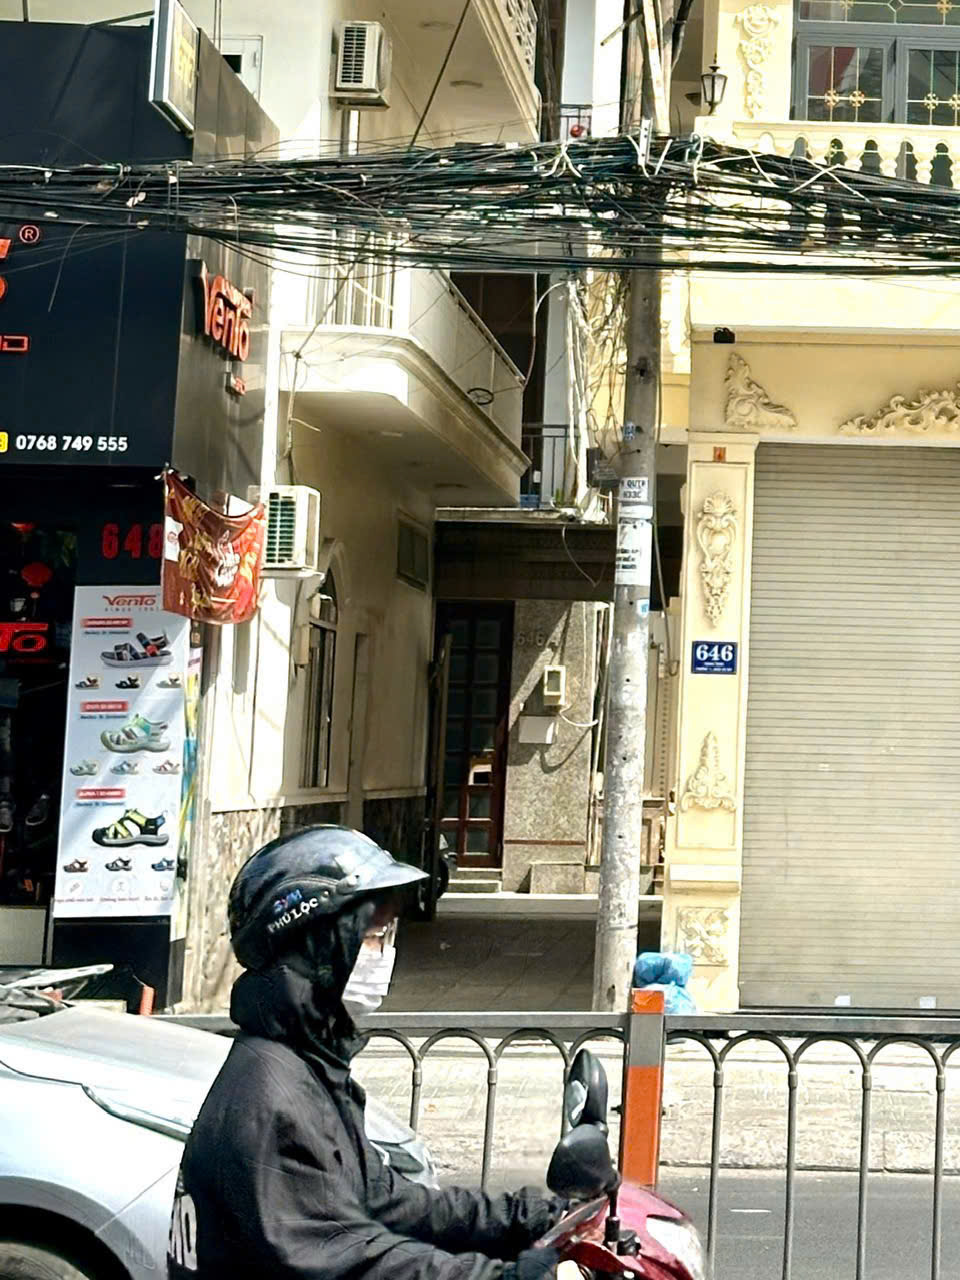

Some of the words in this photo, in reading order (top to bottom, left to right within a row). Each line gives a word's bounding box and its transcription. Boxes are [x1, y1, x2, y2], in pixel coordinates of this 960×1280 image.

[15, 435, 57, 450] 0768
[62, 435, 93, 451] 749
[97, 436, 128, 452] 555
[695, 644, 734, 662] 646
